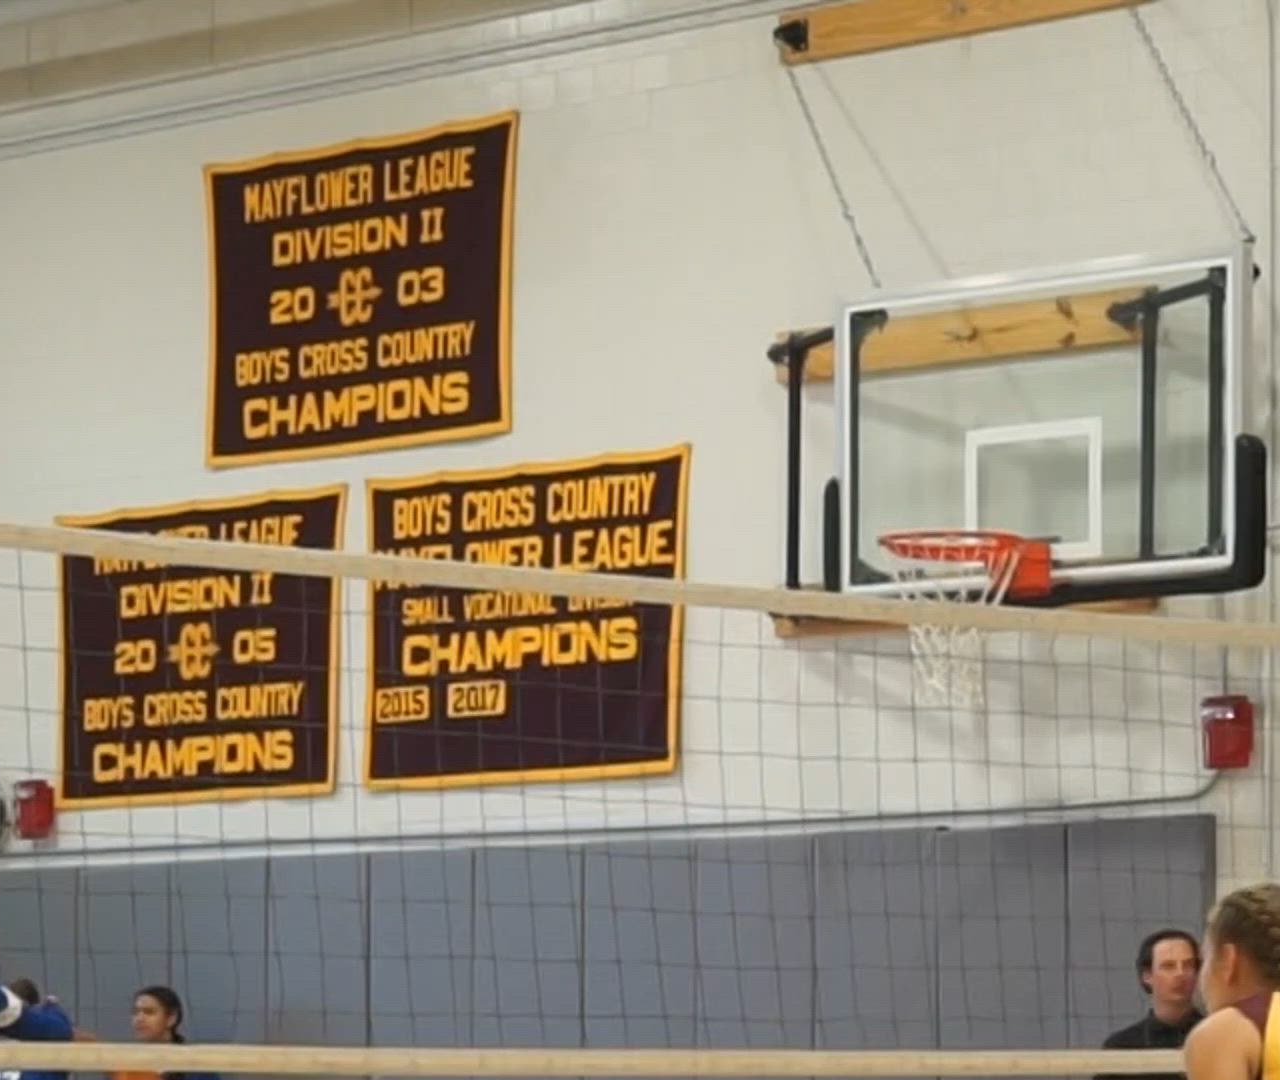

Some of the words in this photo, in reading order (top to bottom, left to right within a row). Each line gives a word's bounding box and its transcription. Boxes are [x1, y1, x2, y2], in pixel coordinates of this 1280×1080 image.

[243, 163, 373, 224] MAYFLOWER
[384, 146, 475, 201] LEAGUE
[272, 212, 408, 267] DIVISION
[420, 208, 444, 243] II
[269, 286, 315, 325] 20
[396, 266, 445, 306] 03
[235, 348, 290, 387] BOYS
[298, 337, 368, 379] CROSS
[376, 321, 475, 368] COUNTRY
[242, 371, 470, 440] CHAMPIONS
[393, 494, 452, 540] BOYS
[461, 485, 536, 533] CROSS
[547, 472, 657, 524] COUNTRY
[553, 520, 675, 571] LEAGUE
[120, 575, 241, 618] DIVISION
[402, 596, 454, 626] SMALL
[464, 589, 557, 621] VOCATIONAL
[114, 638, 157, 675] 20
[232, 627, 277, 664] 05
[402, 616, 639, 677] CHAMPIONS
[83, 696, 135, 732] BOYS
[143, 690, 207, 727] CROSS
[216, 681, 305, 720] COUNTRY
[379, 689, 425, 719] 2015
[453, 685, 502, 714] 2017
[93, 730, 295, 783] CHAMPIONS
